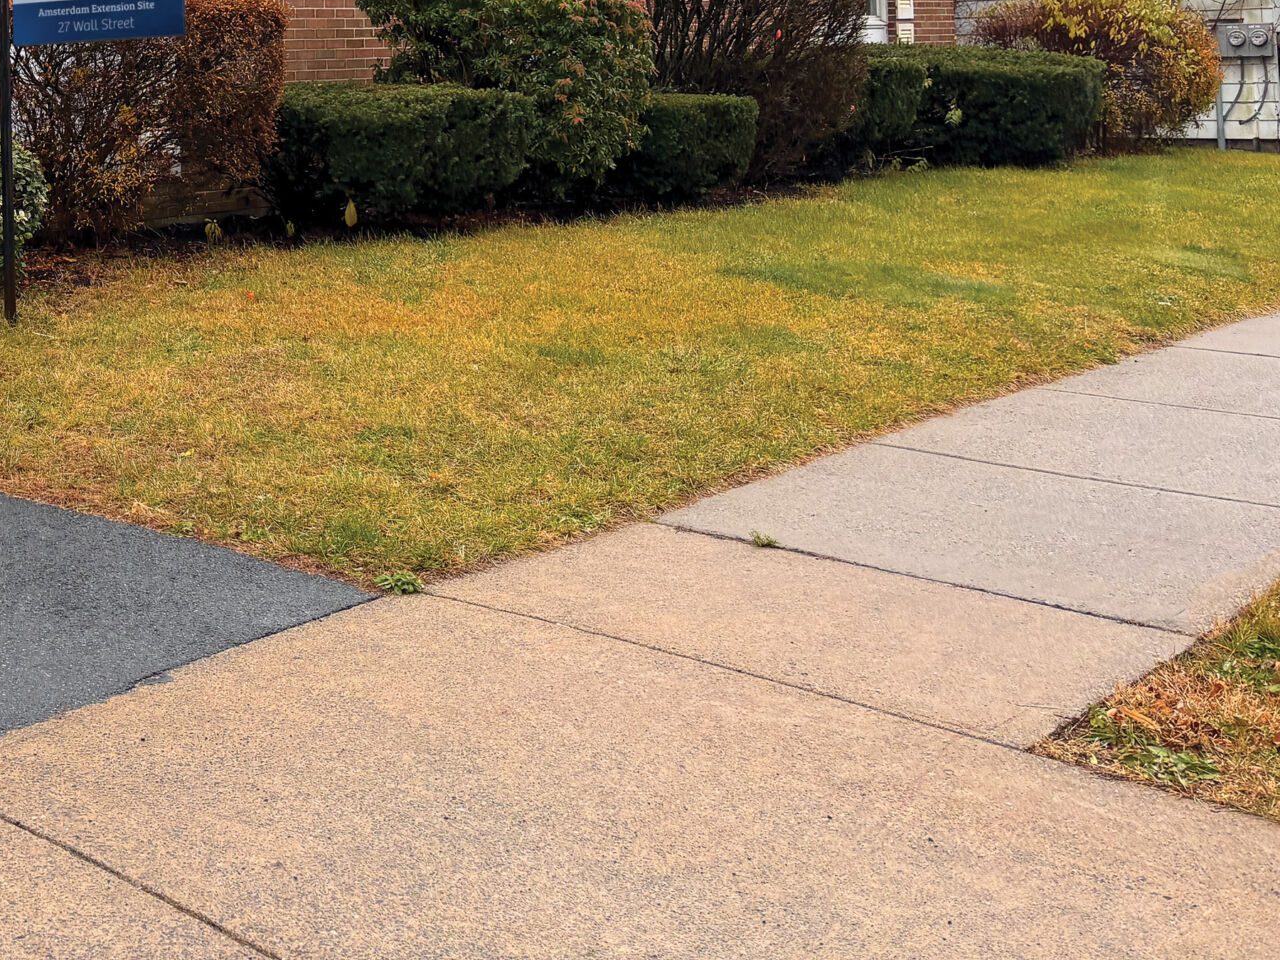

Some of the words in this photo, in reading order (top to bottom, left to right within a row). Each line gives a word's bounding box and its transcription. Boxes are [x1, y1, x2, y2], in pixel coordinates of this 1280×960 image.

[38, 4, 90, 17] Amsterdam
[91, 1, 136, 14] Extension
[137, 0, 155, 10] Site
[57, 21, 71, 33] 27
[73, 19, 99, 32] Wall
[102, 16, 135, 31] Street
